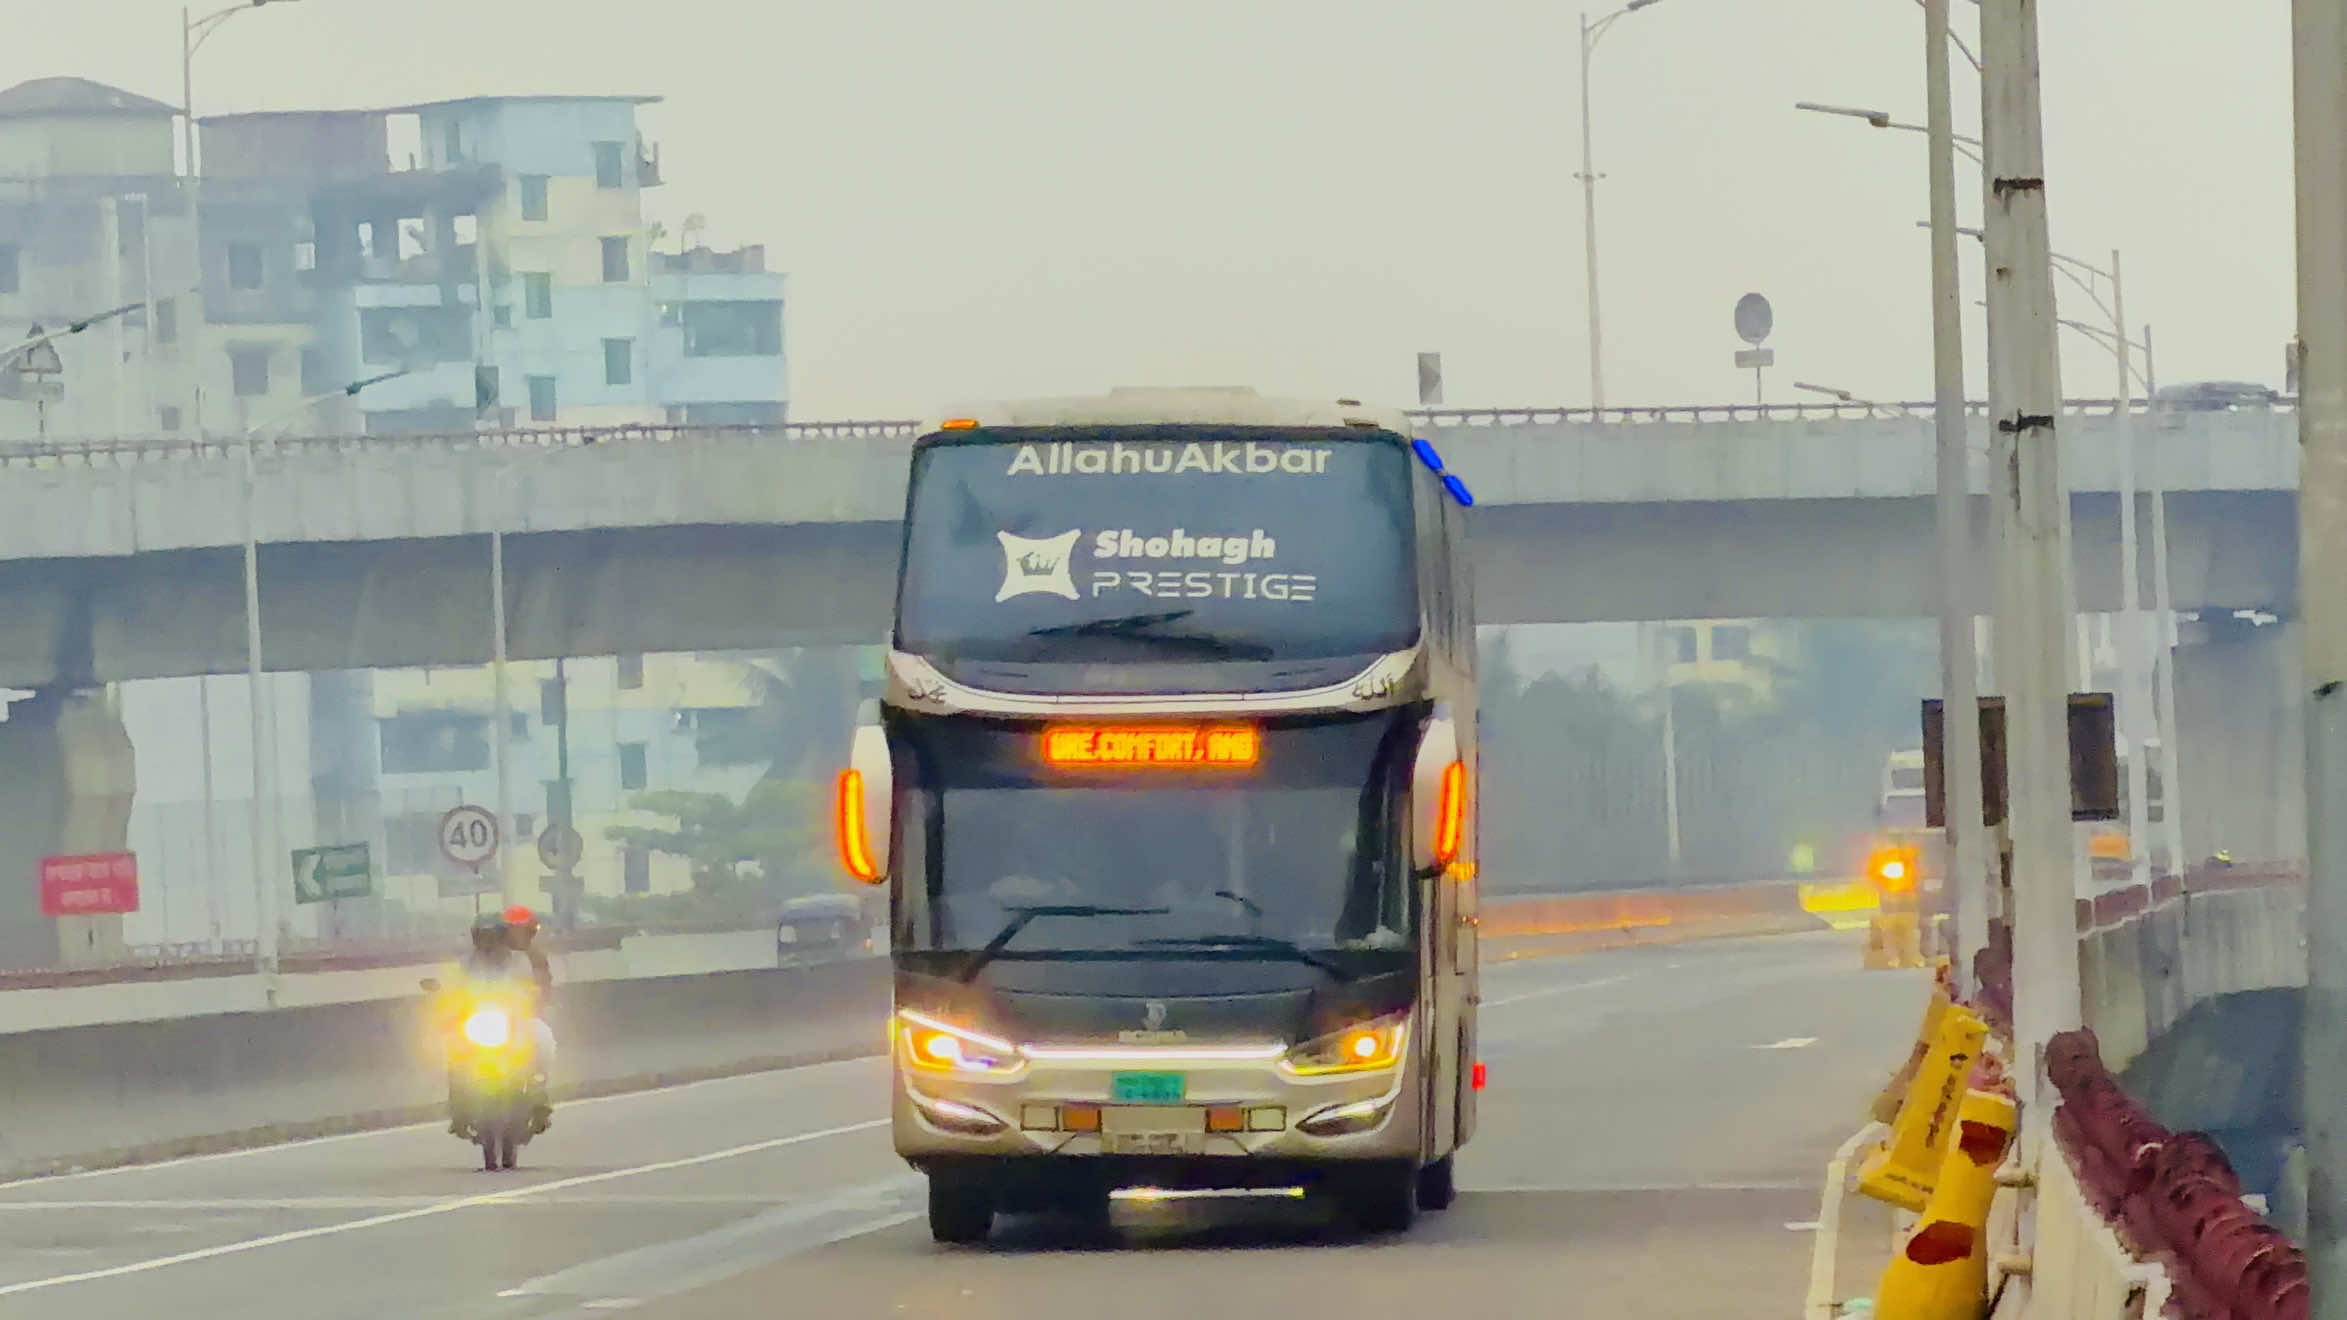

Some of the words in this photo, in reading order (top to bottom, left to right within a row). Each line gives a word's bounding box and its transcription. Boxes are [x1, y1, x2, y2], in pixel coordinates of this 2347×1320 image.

[1008, 443, 1331, 475] AllahuAkbar
[1093, 529, 1276, 564] Shohagh
[1092, 572, 1317, 601] PRESTIGE
[449, 819, 488, 849] 40
